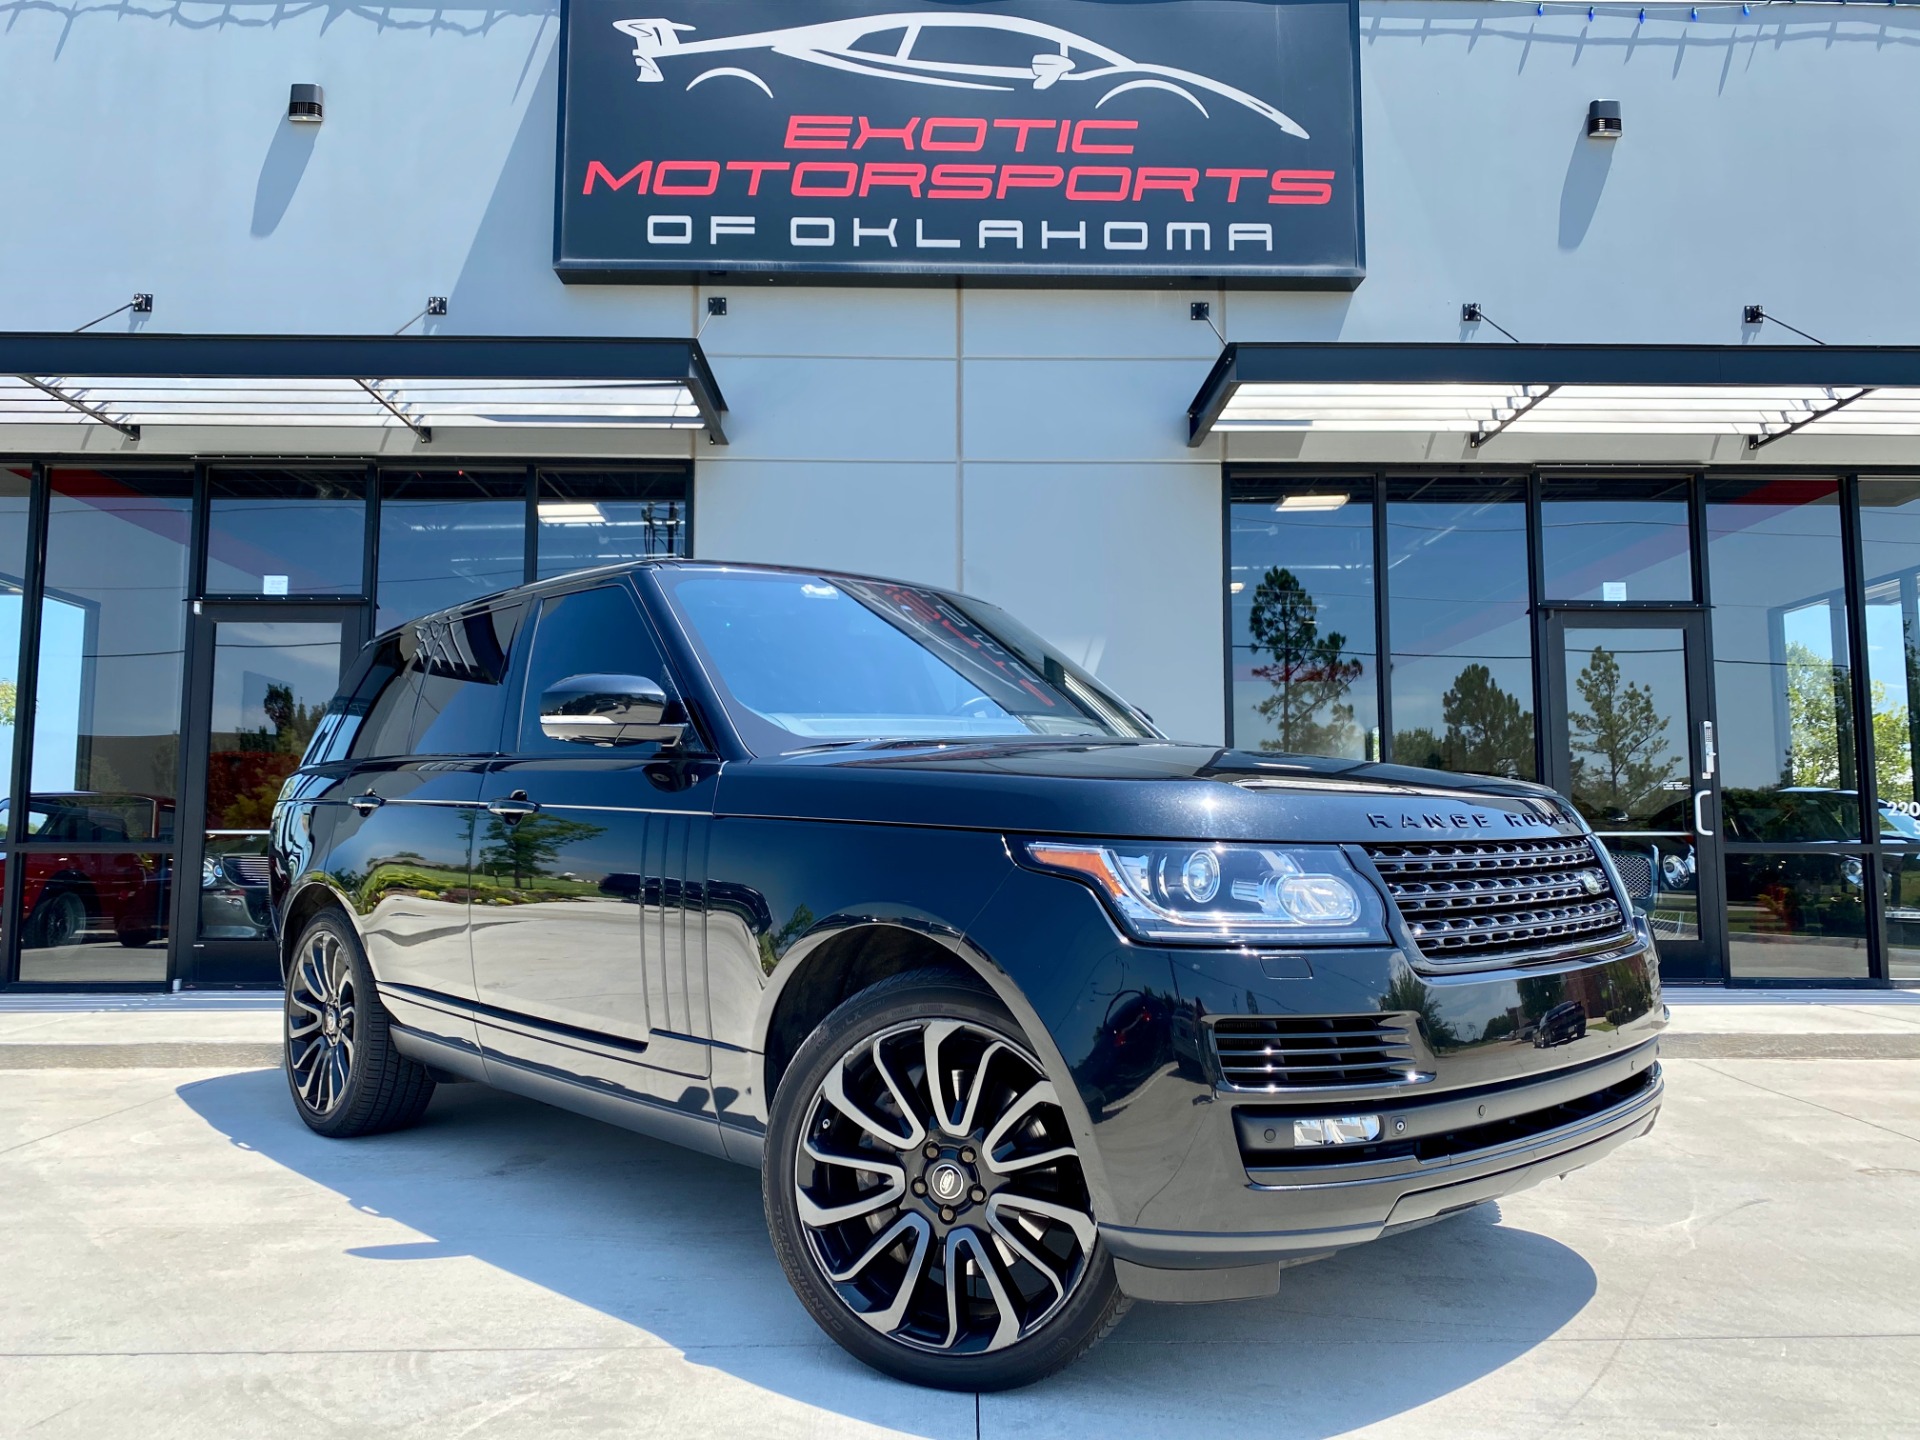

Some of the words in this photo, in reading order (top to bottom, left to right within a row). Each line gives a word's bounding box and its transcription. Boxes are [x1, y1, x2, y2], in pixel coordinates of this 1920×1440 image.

[783, 115, 1139, 154] EXOTIC
[582, 161, 1335, 204] MOTORSPORTS
[647, 215, 755, 245] OF
[790, 217, 1272, 251] OKLAHOMA
[1366, 813, 1491, 829] RANGE
[1504, 812, 1577, 828] ROVER
